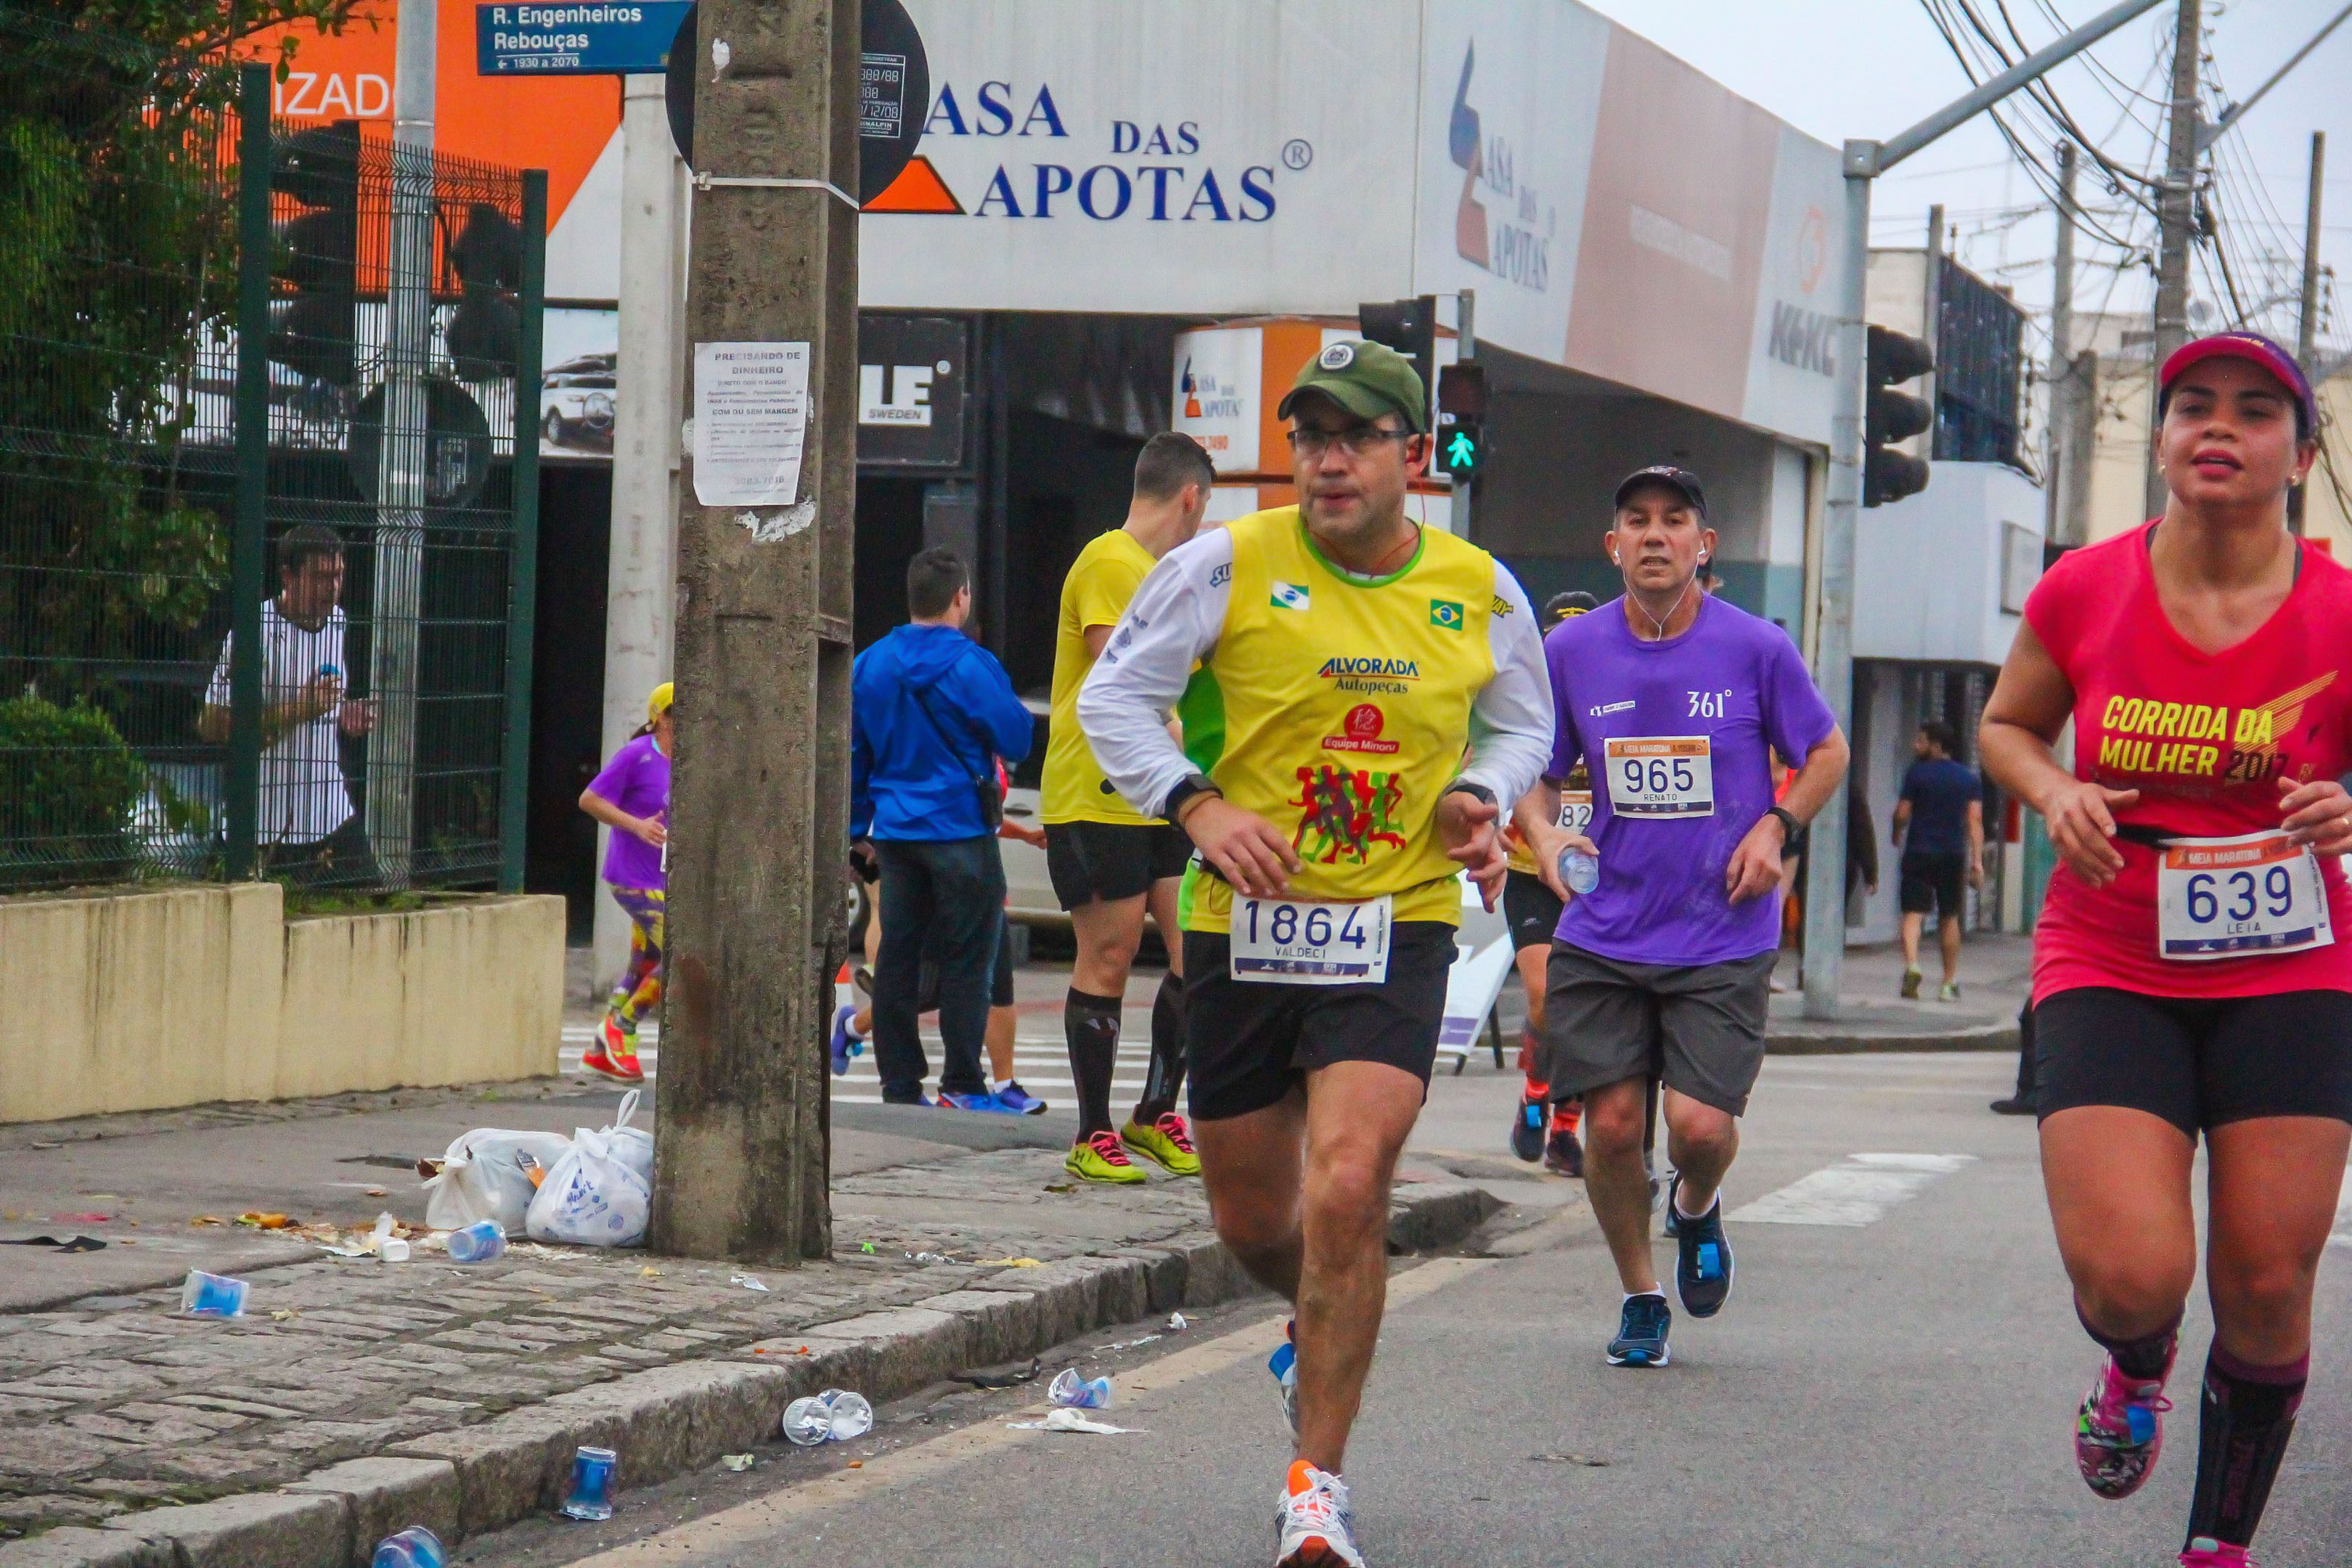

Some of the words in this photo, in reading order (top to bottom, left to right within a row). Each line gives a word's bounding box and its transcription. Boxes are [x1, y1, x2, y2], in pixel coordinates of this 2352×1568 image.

[494, 7, 512, 25] R.
[518, 4, 642, 28] Engenheiros
[494, 31, 589, 52] Rebouças
[514, 58, 538, 68] 1930
[552, 57, 579, 67] 2070
[1111, 121, 1200, 155] DAS
[973, 163, 1276, 223] APOTAS
[868, 409, 921, 419] SWEDEN
[1317, 657, 1419, 677] ALVORADA
[1334, 678, 1408, 695] Autopeças
[2102, 695, 2228, 741] CORRIDA
[2234, 708, 2273, 744] DA
[1325, 738, 1358, 748] Equipe
[1361, 740, 1395, 751] Minoru
[2099, 735, 2218, 775] MULHER
[2224, 750, 2290, 783] 2017
[1624, 759, 1694, 793] 965
[2189, 852, 2213, 865] MEIA
[2214, 848, 2262, 863] MARATONA
[2187, 865, 2292, 923] 639
[1245, 899, 1366, 950] 1864
[2228, 922, 2261, 934] LEIA
[1275, 946, 1326, 959] VALDECI
